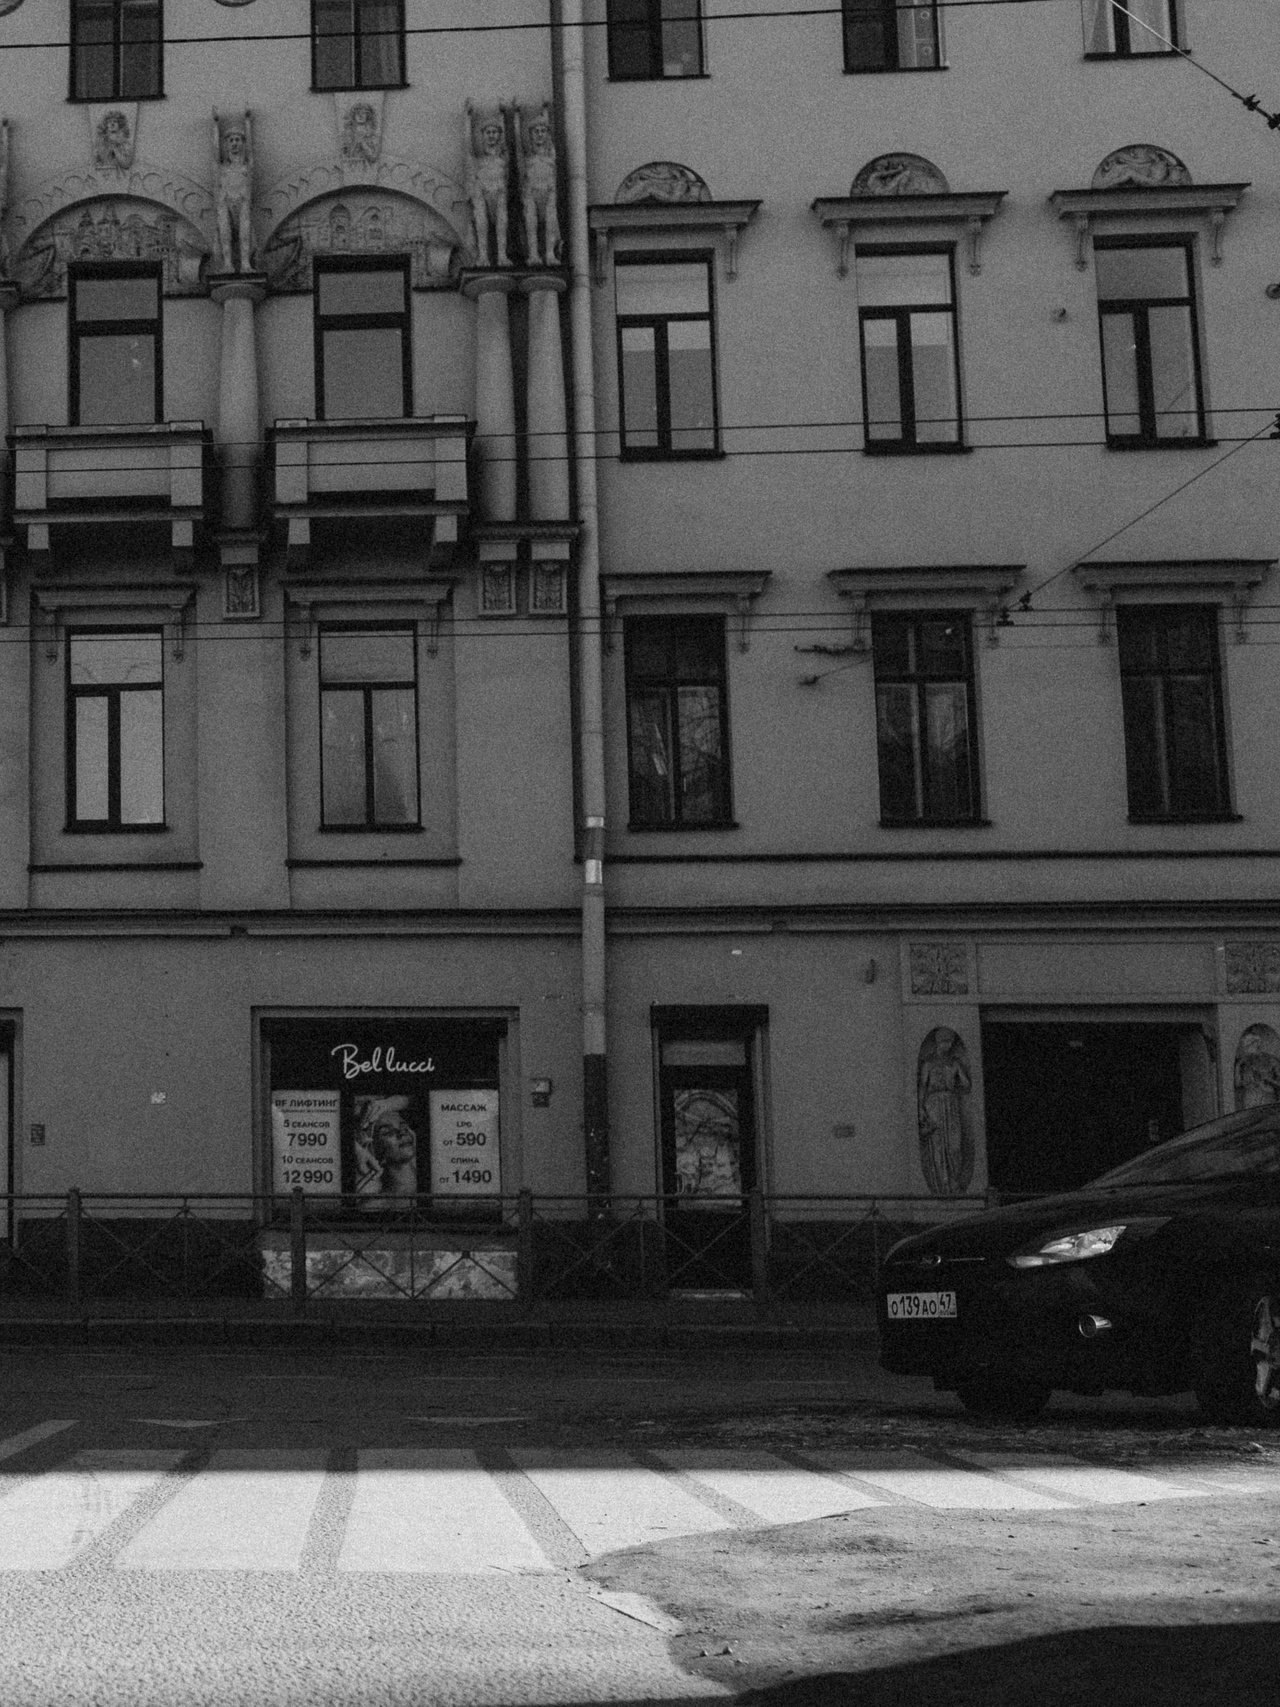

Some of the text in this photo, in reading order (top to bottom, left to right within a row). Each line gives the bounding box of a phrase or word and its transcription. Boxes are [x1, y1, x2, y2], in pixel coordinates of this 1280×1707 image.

[289, 1099, 338, 1107] ЛИФТИНГ
[441, 1104, 487, 1112] МАССАЖ
[283, 1119, 290, 1128] 5
[287, 1132, 328, 1147] 7990
[456, 1132, 487, 1147] 590
[282, 1155, 294, 1164] 10
[452, 1169, 492, 1184] 1490
[939, 1293, 952, 1310] 47
